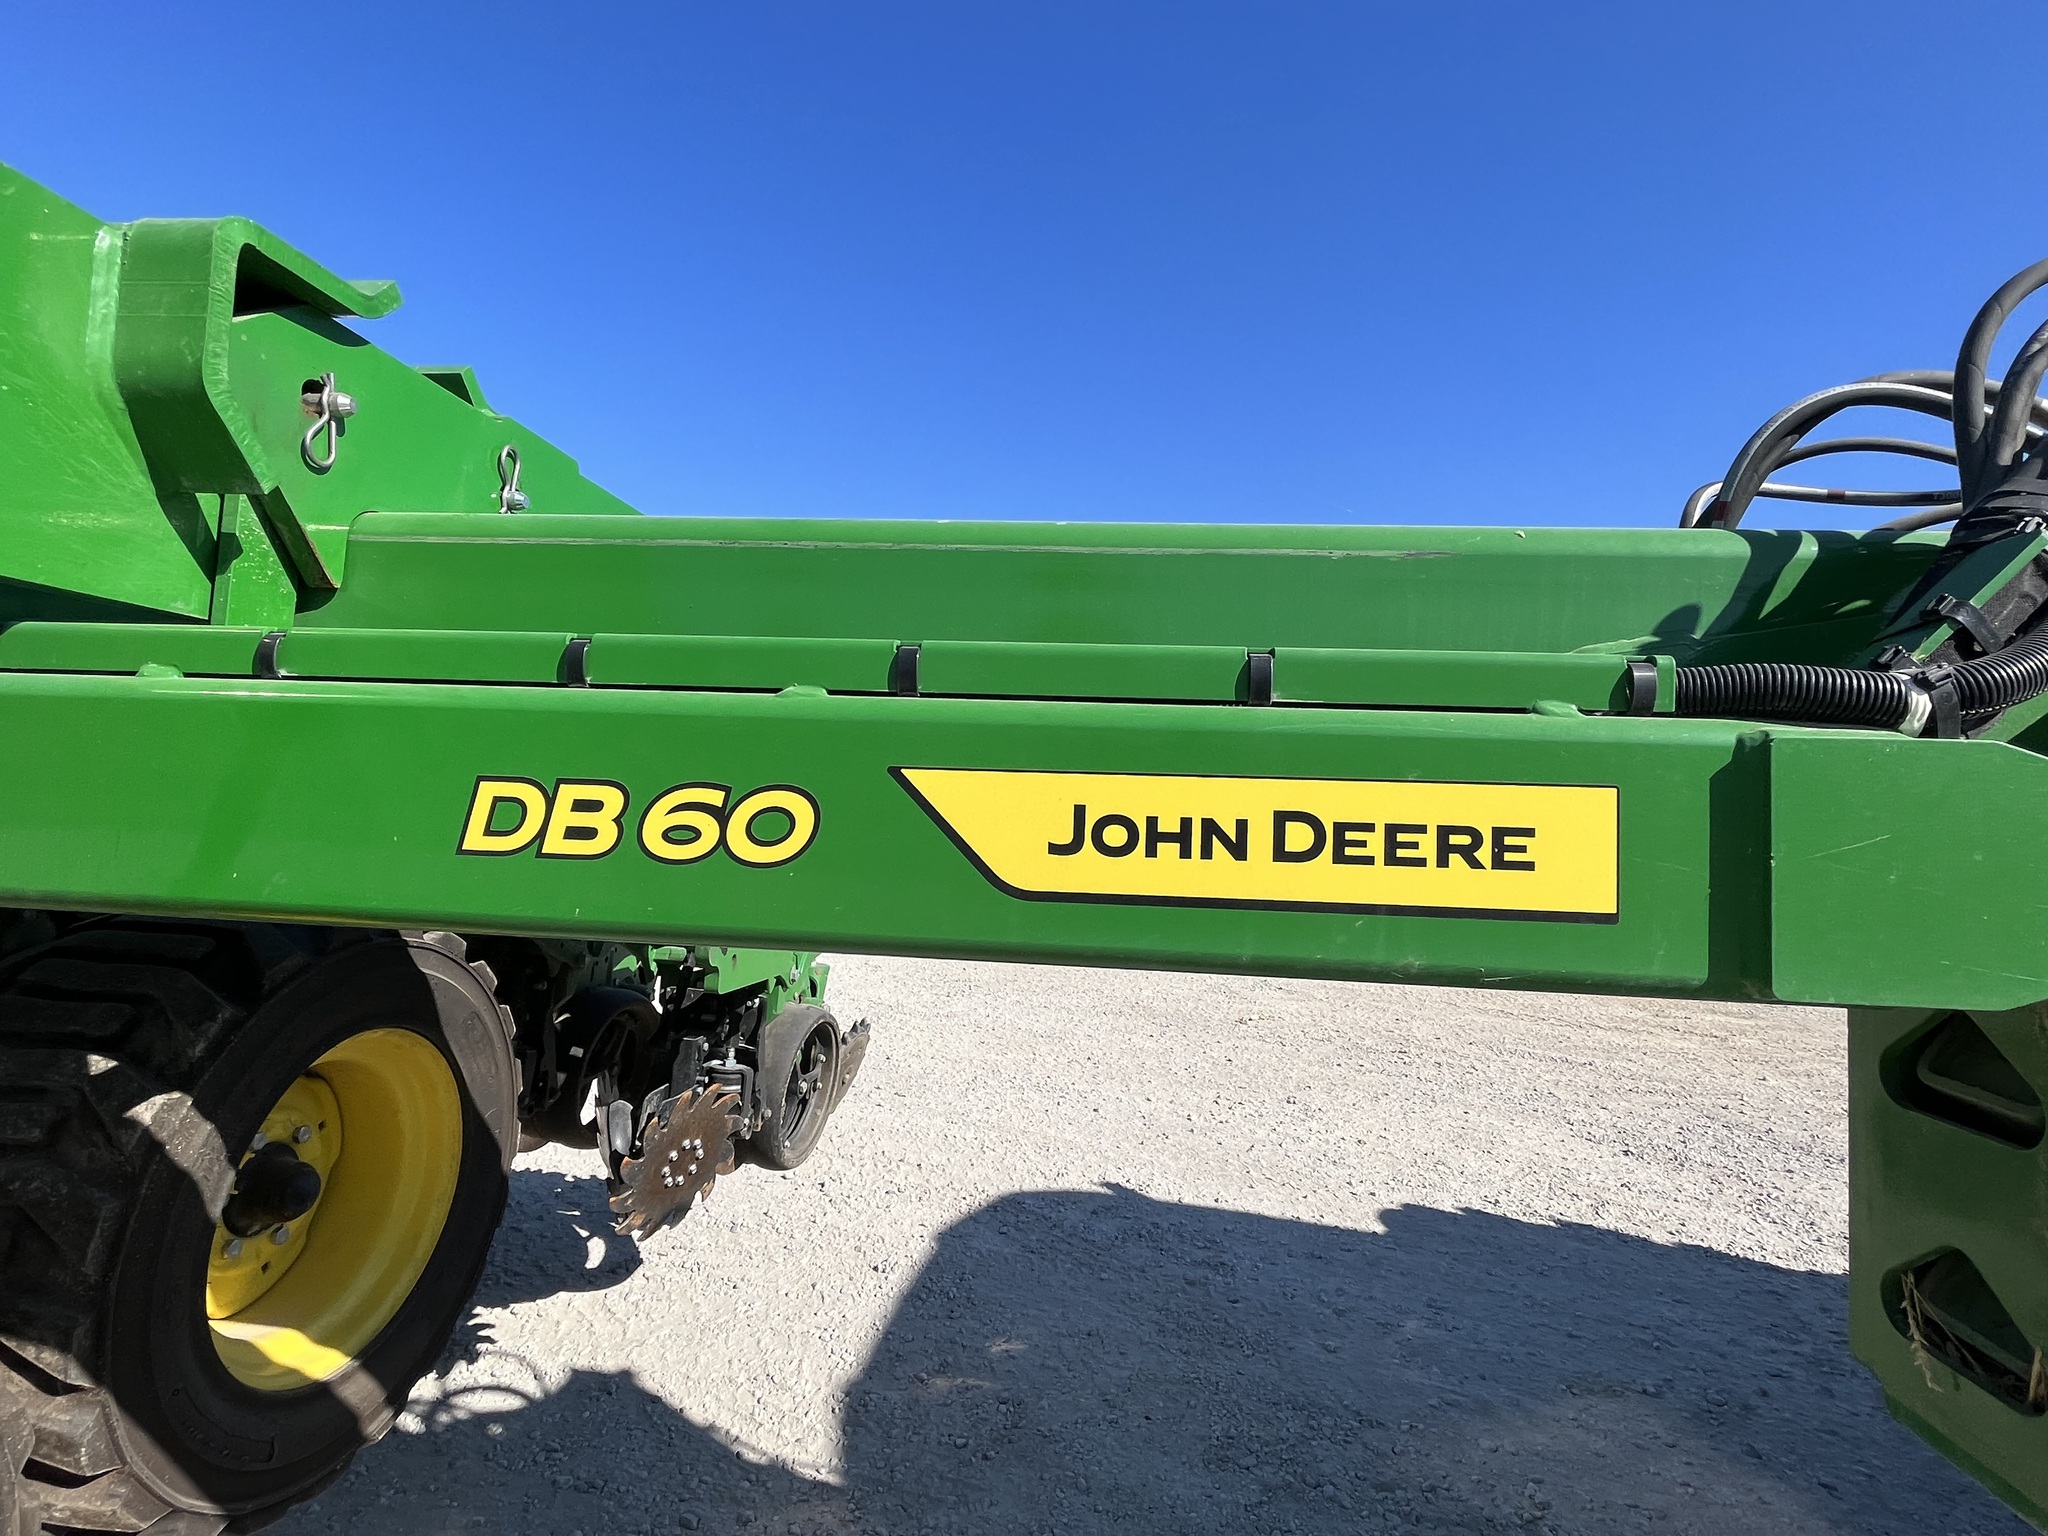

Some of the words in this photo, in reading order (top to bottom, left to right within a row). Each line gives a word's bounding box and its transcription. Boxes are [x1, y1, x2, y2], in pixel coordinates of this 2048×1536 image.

[457, 776, 629, 859] DB
[638, 783, 819, 867] 60
[1047, 804, 1249, 862] JOHN
[1272, 809, 1536, 872] DEERE
